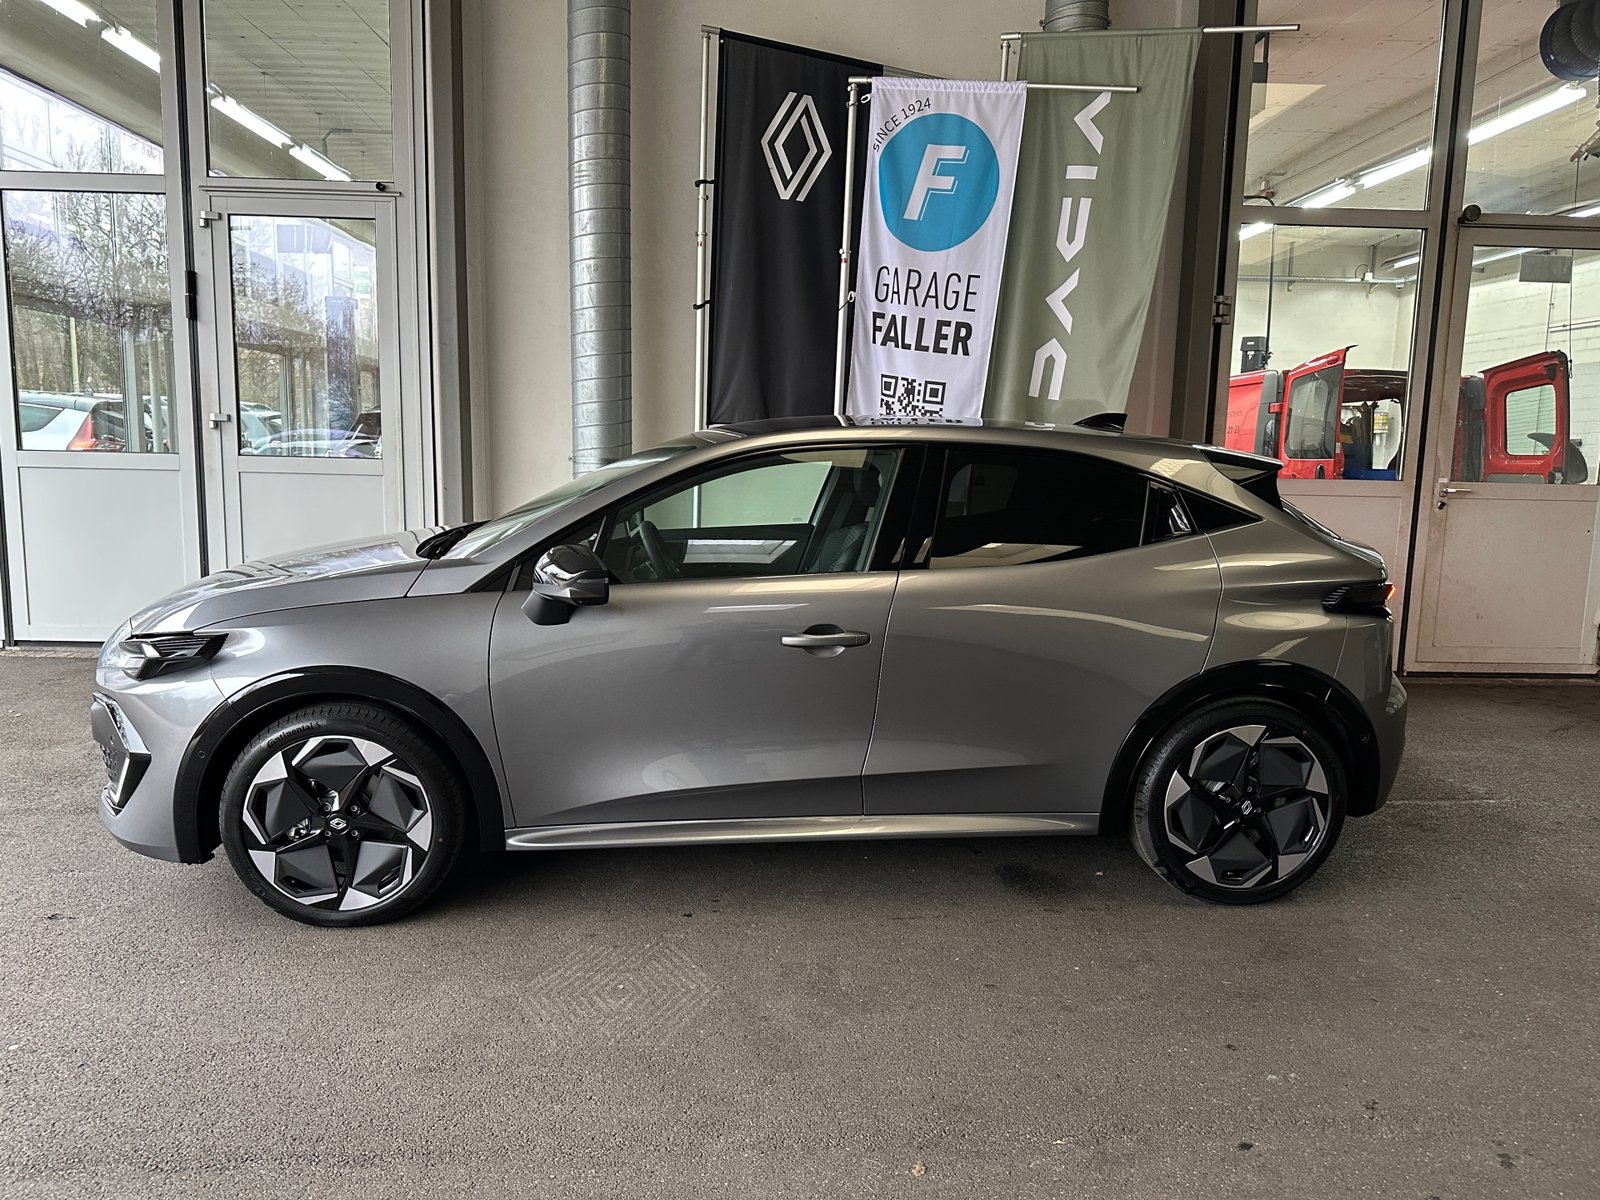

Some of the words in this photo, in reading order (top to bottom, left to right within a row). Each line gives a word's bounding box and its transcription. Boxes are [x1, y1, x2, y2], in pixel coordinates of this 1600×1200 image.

[872, 114, 901, 152] SINCE
[900, 97, 931, 120] 1924
[903, 143, 970, 221] F
[875, 265, 981, 312] GARAGE
[872, 311, 973, 357] FALLER
[266, 722, 314, 748] Continental
